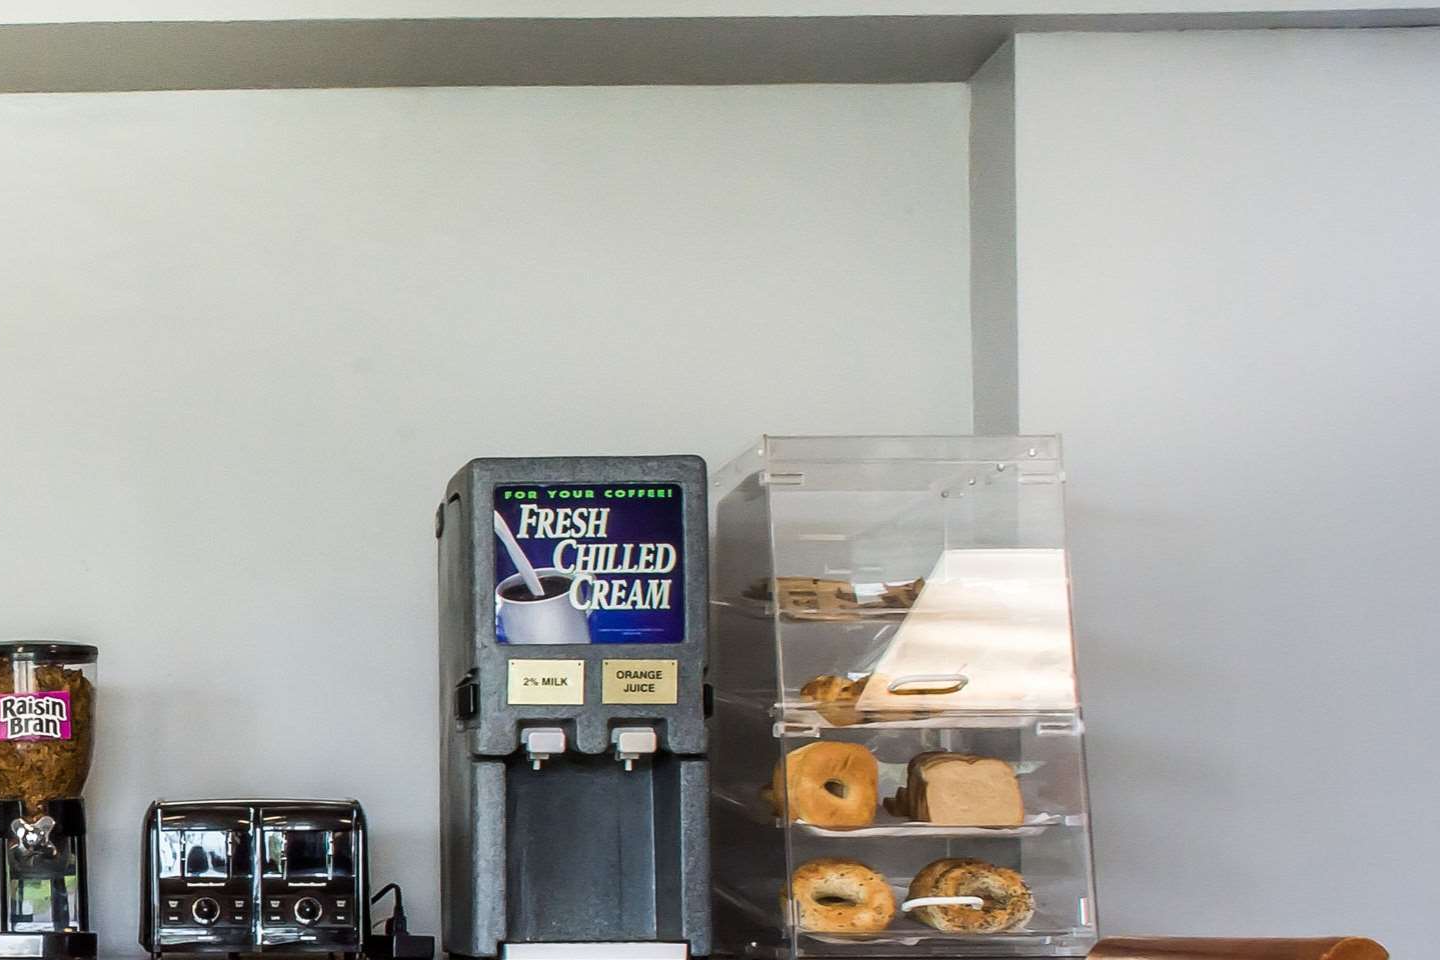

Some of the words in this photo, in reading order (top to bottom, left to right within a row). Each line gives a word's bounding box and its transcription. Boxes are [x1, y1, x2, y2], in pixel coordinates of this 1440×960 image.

[504, 490, 538, 499] FOR
[547, 490, 595, 498] YOUR
[604, 489, 673, 498] COFFEE!
[516, 503, 611, 539] FRESH
[553, 539, 677, 574] CHILLED
[569, 573, 672, 610] CREAM
[523, 677, 539, 686] 2%
[541, 677, 568, 686] MILK
[616, 670, 663, 680] ORANGE
[623, 683, 656, 693] JUICE
[1, 697, 66, 720] Raisin
[9, 717, 60, 737] Bran
